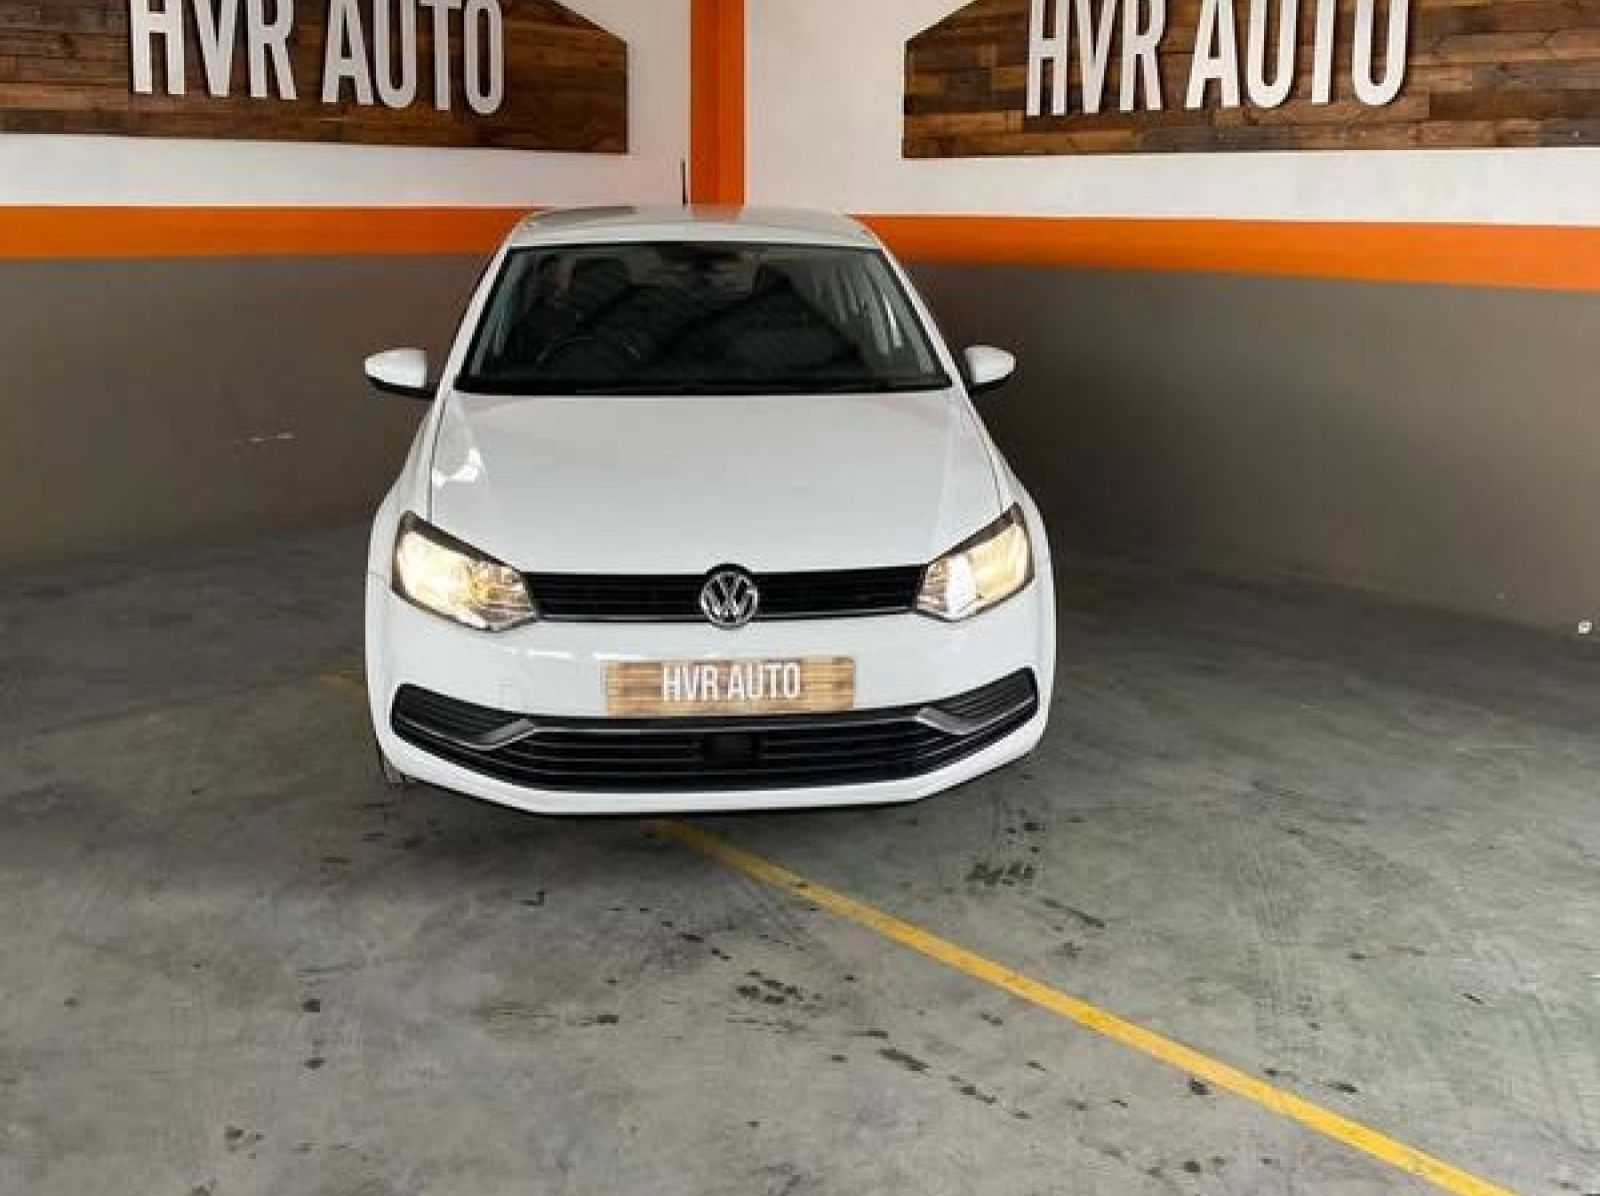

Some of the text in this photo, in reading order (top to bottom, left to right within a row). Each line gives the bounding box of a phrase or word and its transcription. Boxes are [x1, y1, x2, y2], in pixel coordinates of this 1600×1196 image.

[131, 0, 504, 115] HVR AUTO
[1026, 0, 1166, 117] HVR
[662, 661, 801, 702] HVR AUTO
